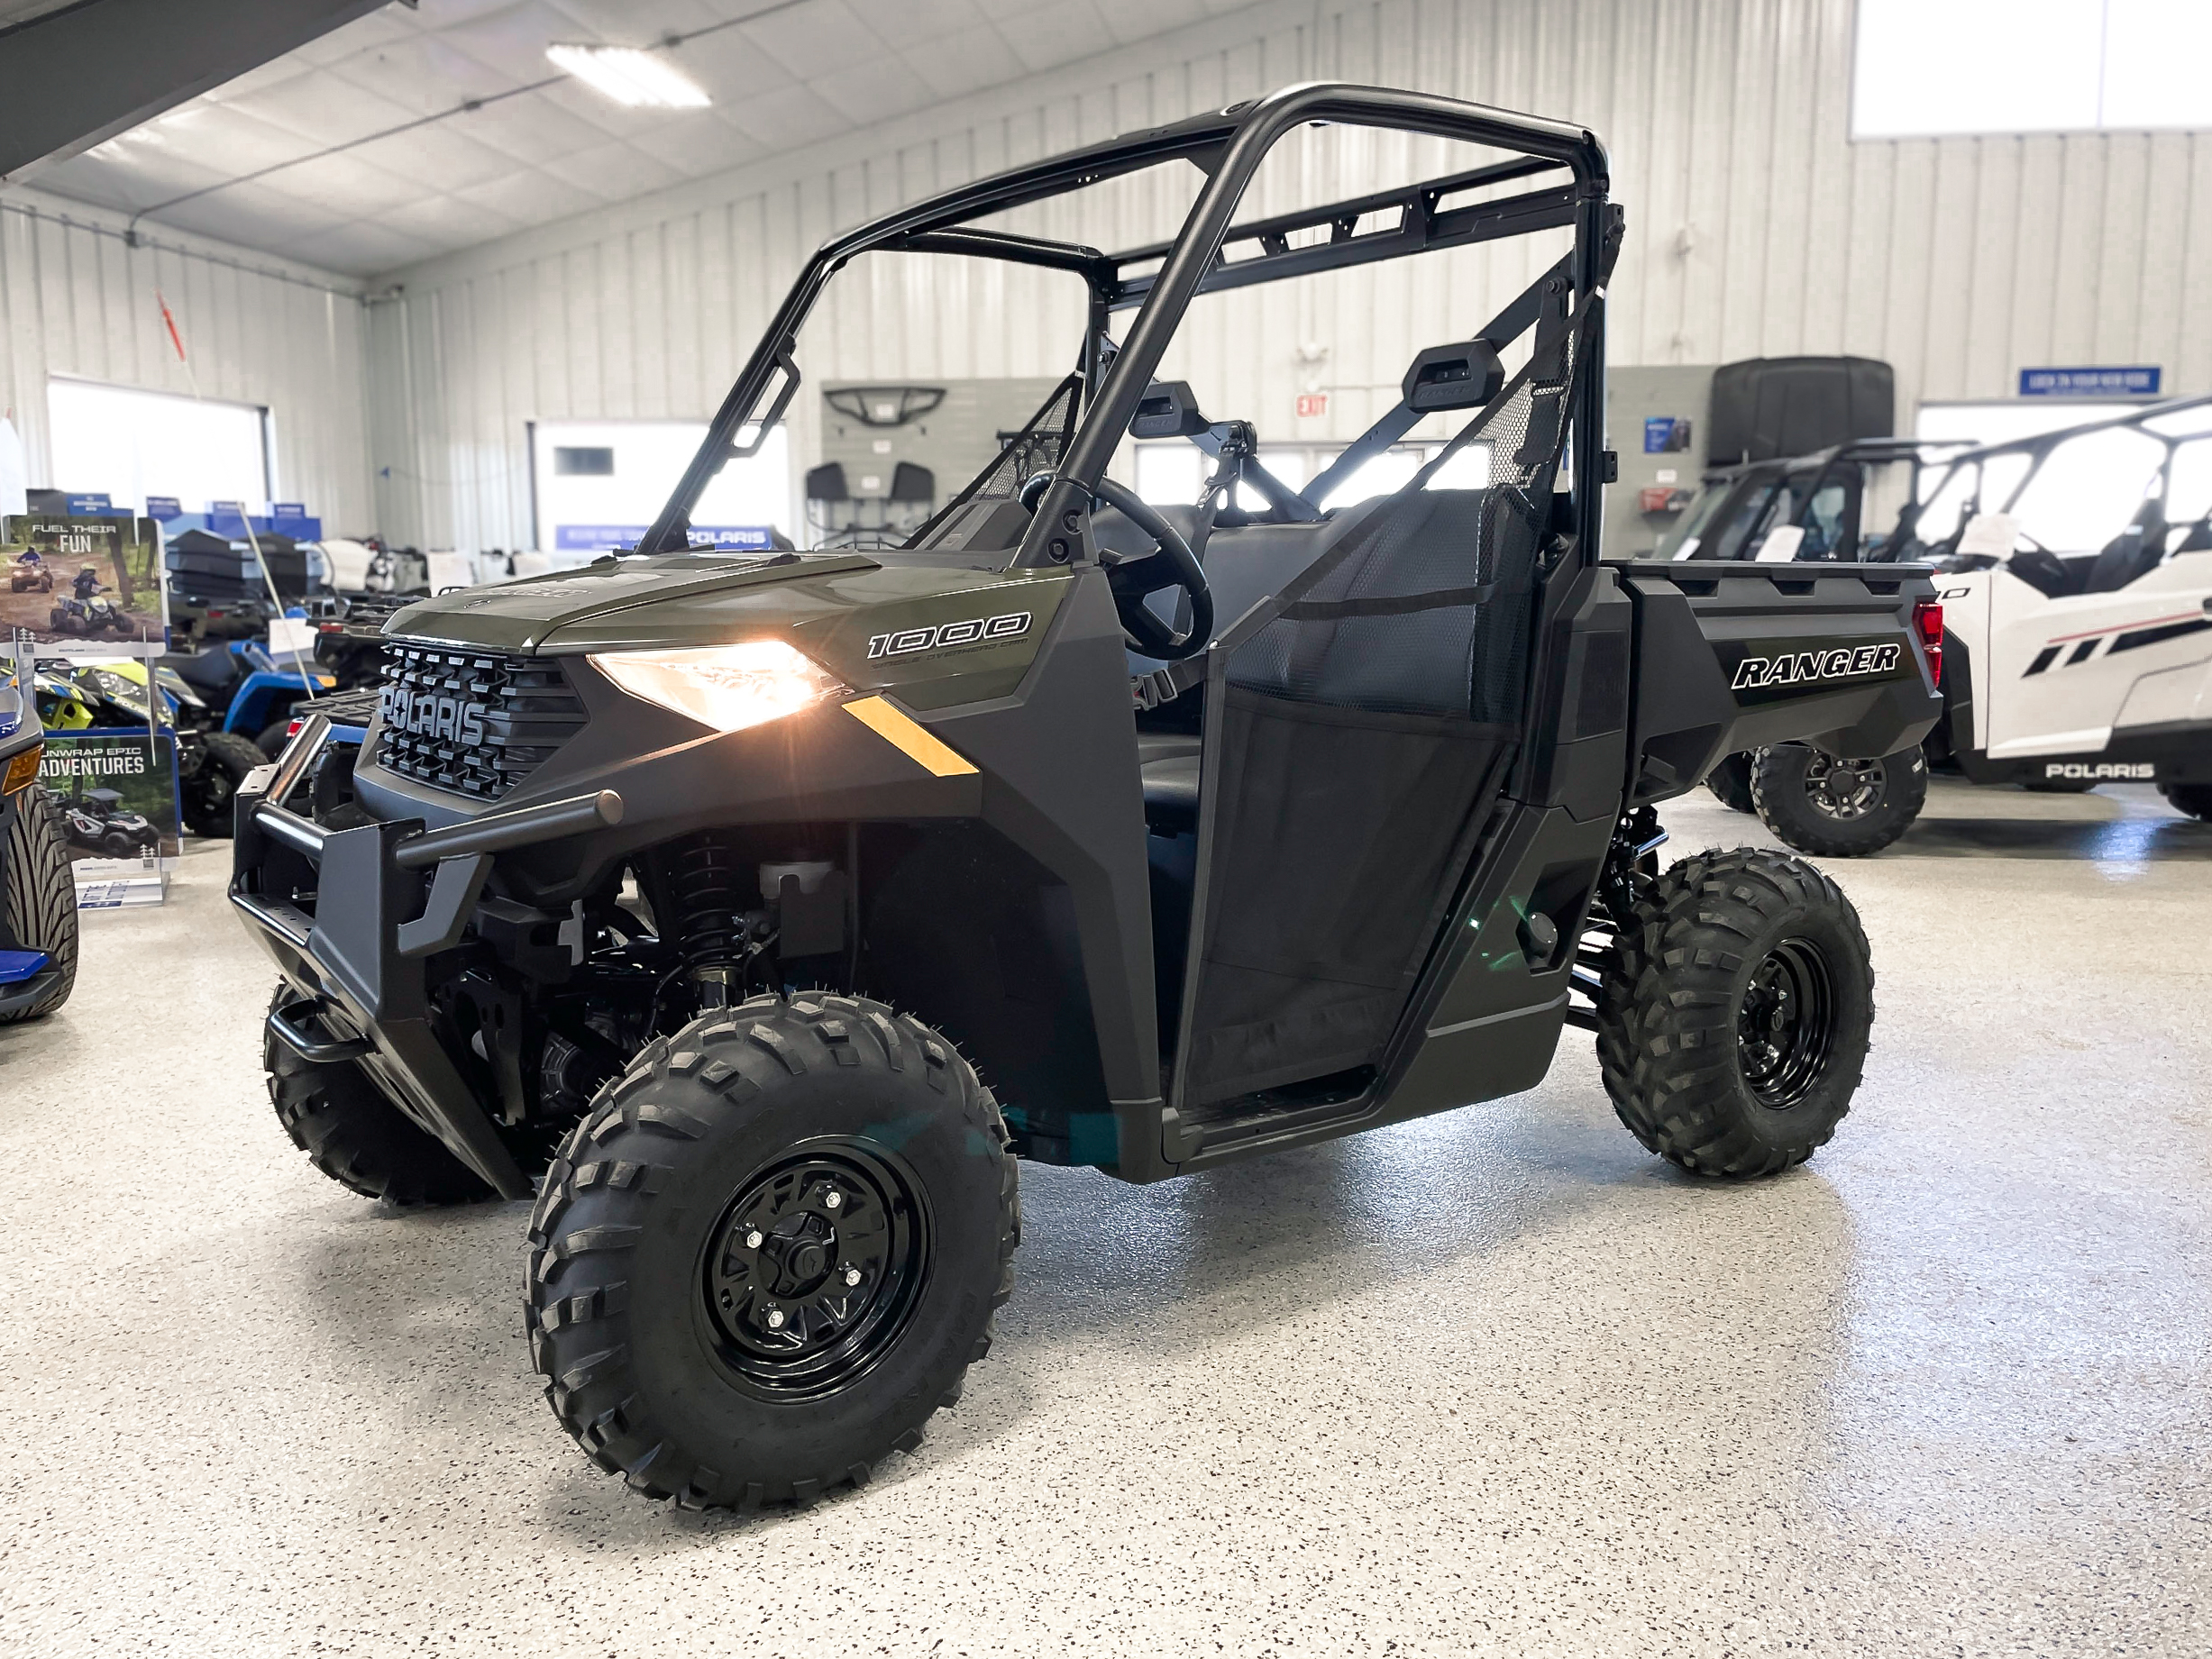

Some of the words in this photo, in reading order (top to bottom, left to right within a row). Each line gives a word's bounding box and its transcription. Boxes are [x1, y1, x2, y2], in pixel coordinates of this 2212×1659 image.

[1296, 395, 1327, 417] EXIT
[32, 524, 69, 533] FUEL
[72, 524, 116, 533] THEIR
[686, 531, 765, 543] POLARIS
[60, 534, 91, 552] FUN
[867, 611, 1033, 660] 1000
[870, 657, 920, 670] SINGLE
[927, 643, 996, 661] OVERHEAD
[1000, 638, 1028, 649] CAM
[1731, 643, 1901, 690] RANGER
[379, 685, 485, 746] POLARIS
[41, 748, 103, 758] UNWRAP
[106, 747, 141, 755] EPIC
[38, 756, 144, 777] ADVENTURES
[2044, 763, 2154, 779] POLARIS
